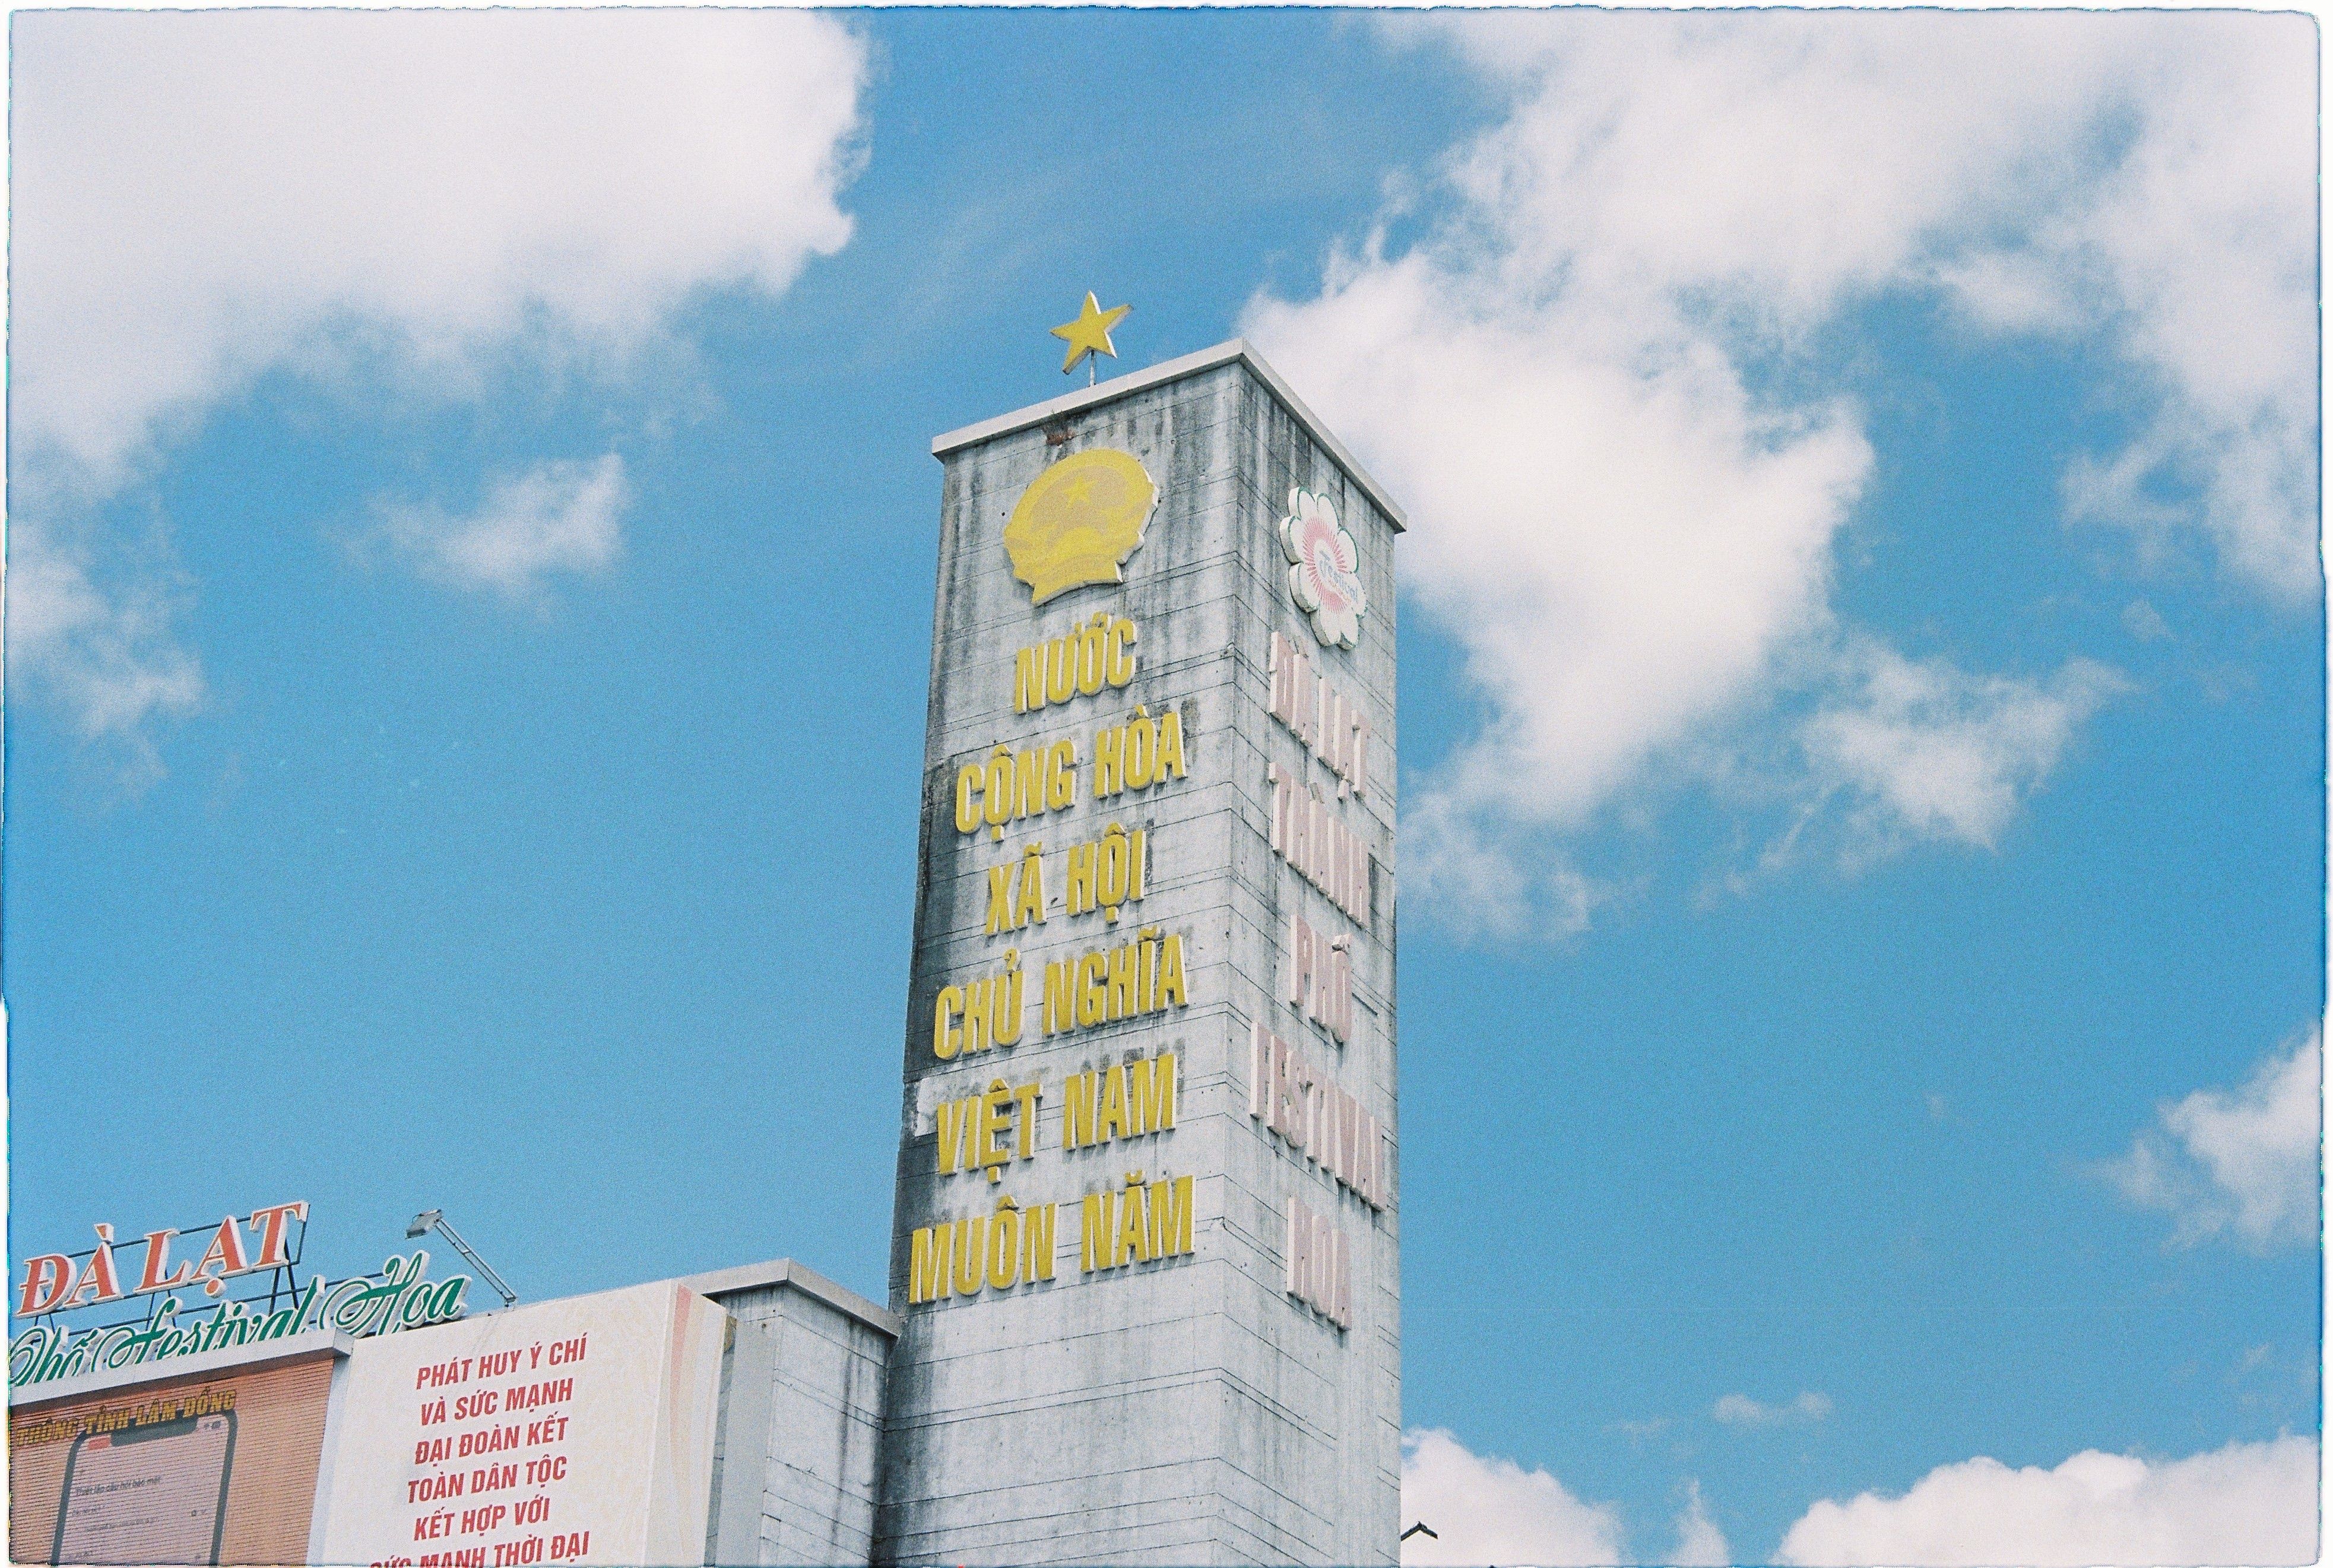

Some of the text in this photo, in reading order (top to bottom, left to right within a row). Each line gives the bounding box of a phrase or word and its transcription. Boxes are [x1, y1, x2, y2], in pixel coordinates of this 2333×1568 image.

[1015, 611, 1137, 715] NƯỚC
[956, 704, 1187, 841] CỘNG HÒA
[1317, 677, 1370, 801] LẠT
[985, 823, 1146, 936] XÃ HỘI
[1269, 762, 1368, 929] THÀNH
[934, 925, 1189, 1060] CHỦ NGHĨA
[1290, 915, 1352, 1043] PHỐ
[937, 1053, 1177, 1185] VIỆT NAM
[15, 1200, 309, 1319] ĐÀ LẠT
[321, 1249, 473, 1337] Hoa
[908, 1170, 1197, 1304] MUÔN NĂM
[1286, 1196, 1352, 1331] HOA
[416, 1332, 588, 1389] PHÁT HUY Ý CHÍ
[421, 1377, 573, 1426] VÀ SỨC MẠNH
[407, 1455, 567, 1503] TOÀN DÂN TỘC
[414, 1411, 569, 1467] ĐẠI ĐOÀN KẾT
[414, 1494, 550, 1541] KẾT HỢP VỚI
[494, 1534, 543, 1567] THỜI
[550, 1531, 589, 1563] ĐẠI
